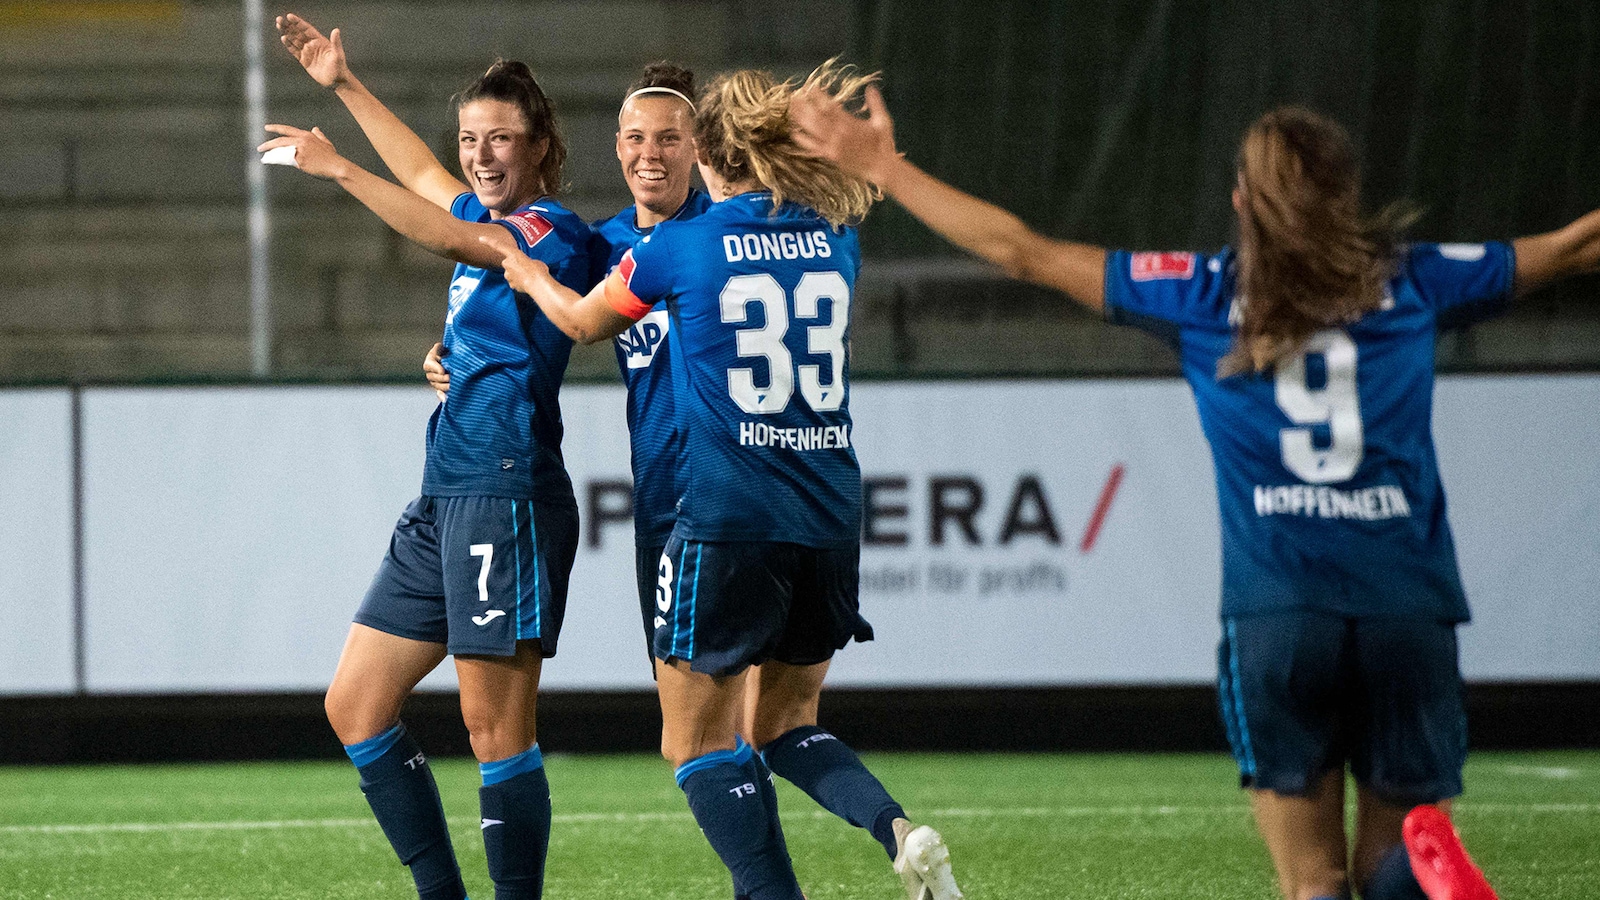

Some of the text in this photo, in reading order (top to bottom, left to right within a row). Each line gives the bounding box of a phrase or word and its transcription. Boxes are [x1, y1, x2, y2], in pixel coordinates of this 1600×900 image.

[723, 231, 832, 263] DONGUS
[616, 322, 662, 358] SAP
[719, 271, 850, 414] 33
[1274, 328, 1364, 484] 9
[470, 543, 493, 602] 7
[404, 750, 426, 771] TS
[729, 782, 757, 799] TS
